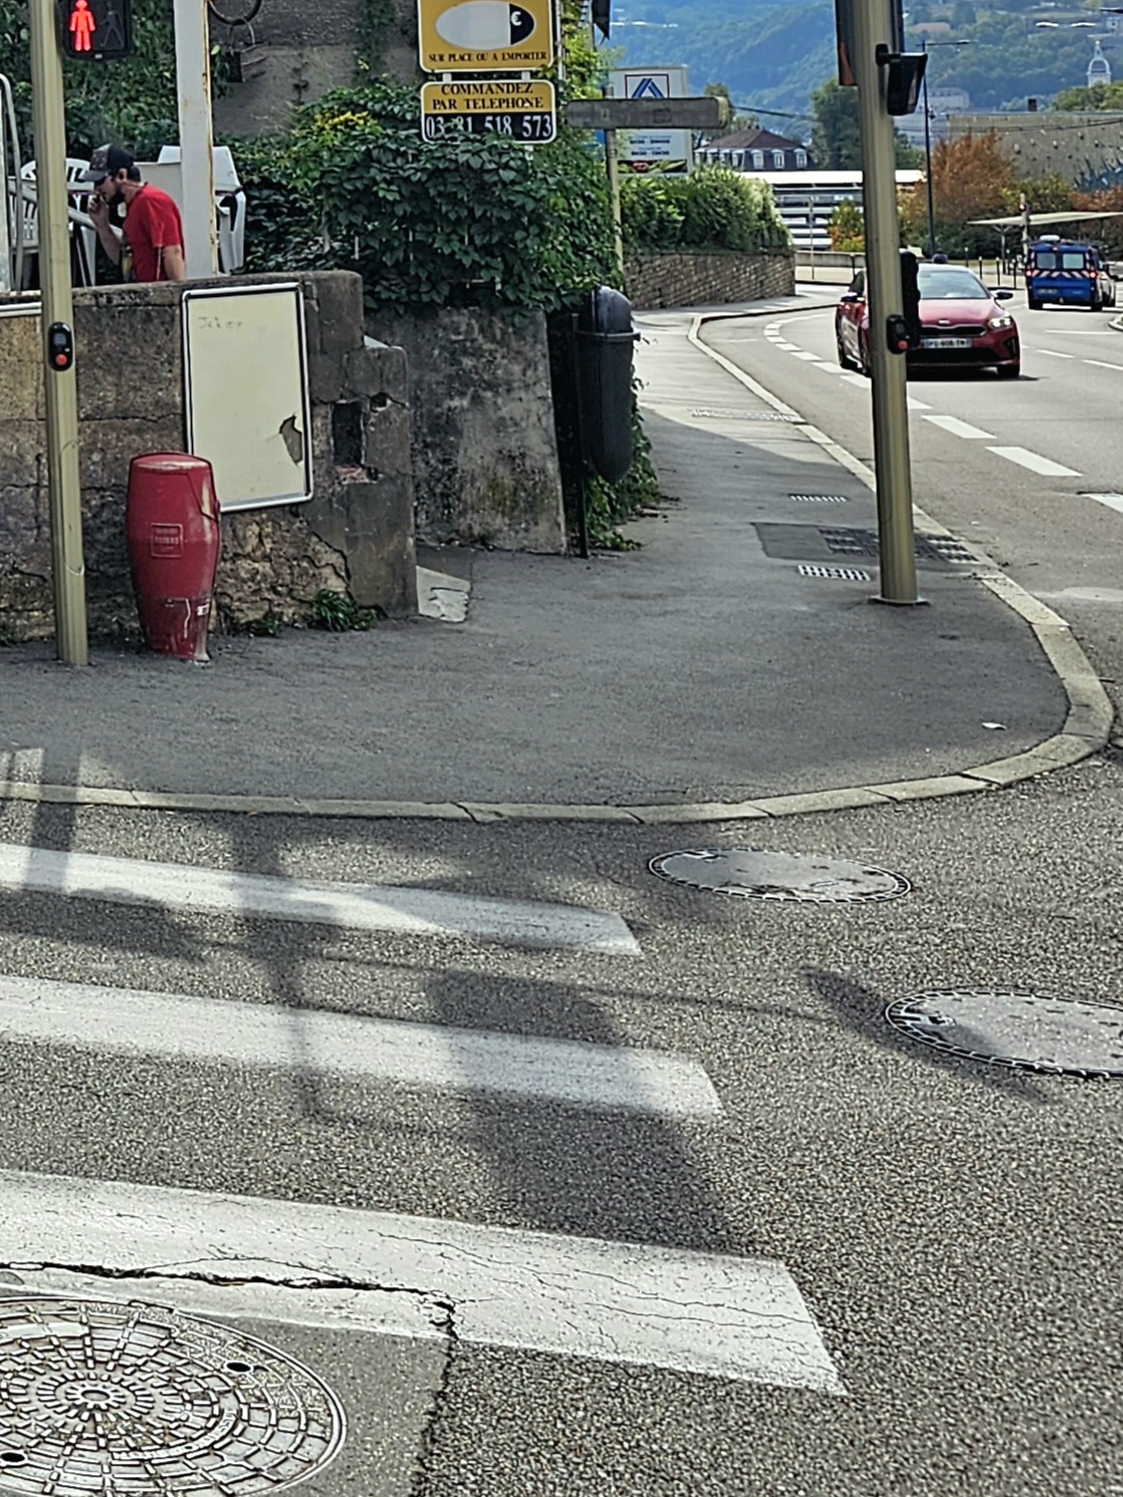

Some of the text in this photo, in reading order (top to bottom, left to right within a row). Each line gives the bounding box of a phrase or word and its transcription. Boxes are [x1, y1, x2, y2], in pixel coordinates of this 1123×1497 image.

[429, 54, 445, 63] SUR
[448, 53, 472, 63] PLACE
[476, 53, 487, 62] OU
[502, 51, 547, 61] EMPORTER
[441, 83, 534, 95] COMMANDEZ
[432, 97, 544, 110] PAR TELEPHONE
[426, 116, 445, 138] 03
[484, 115, 512, 136] 518
[522, 114, 552, 138] 573
